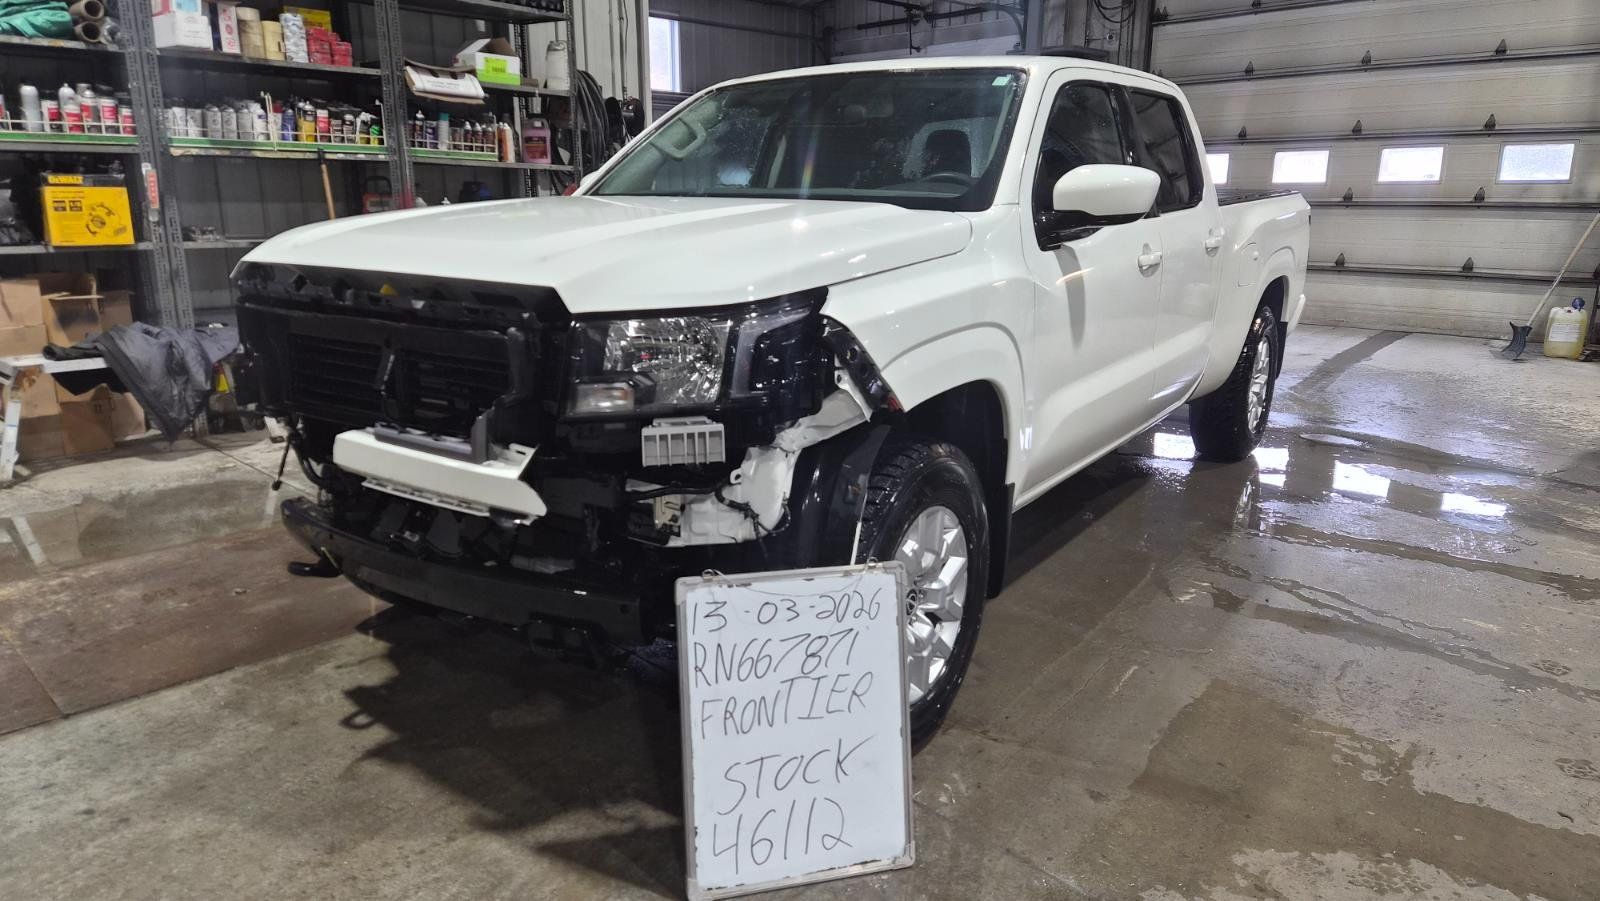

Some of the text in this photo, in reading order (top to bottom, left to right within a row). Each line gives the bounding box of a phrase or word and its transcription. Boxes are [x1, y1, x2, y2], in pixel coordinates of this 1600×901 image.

[694, 628, 859, 688] RN667871
[701, 672, 873, 740] FRONTIER
[717, 736, 875, 816] STOCK
[713, 797, 853, 875] 46112
